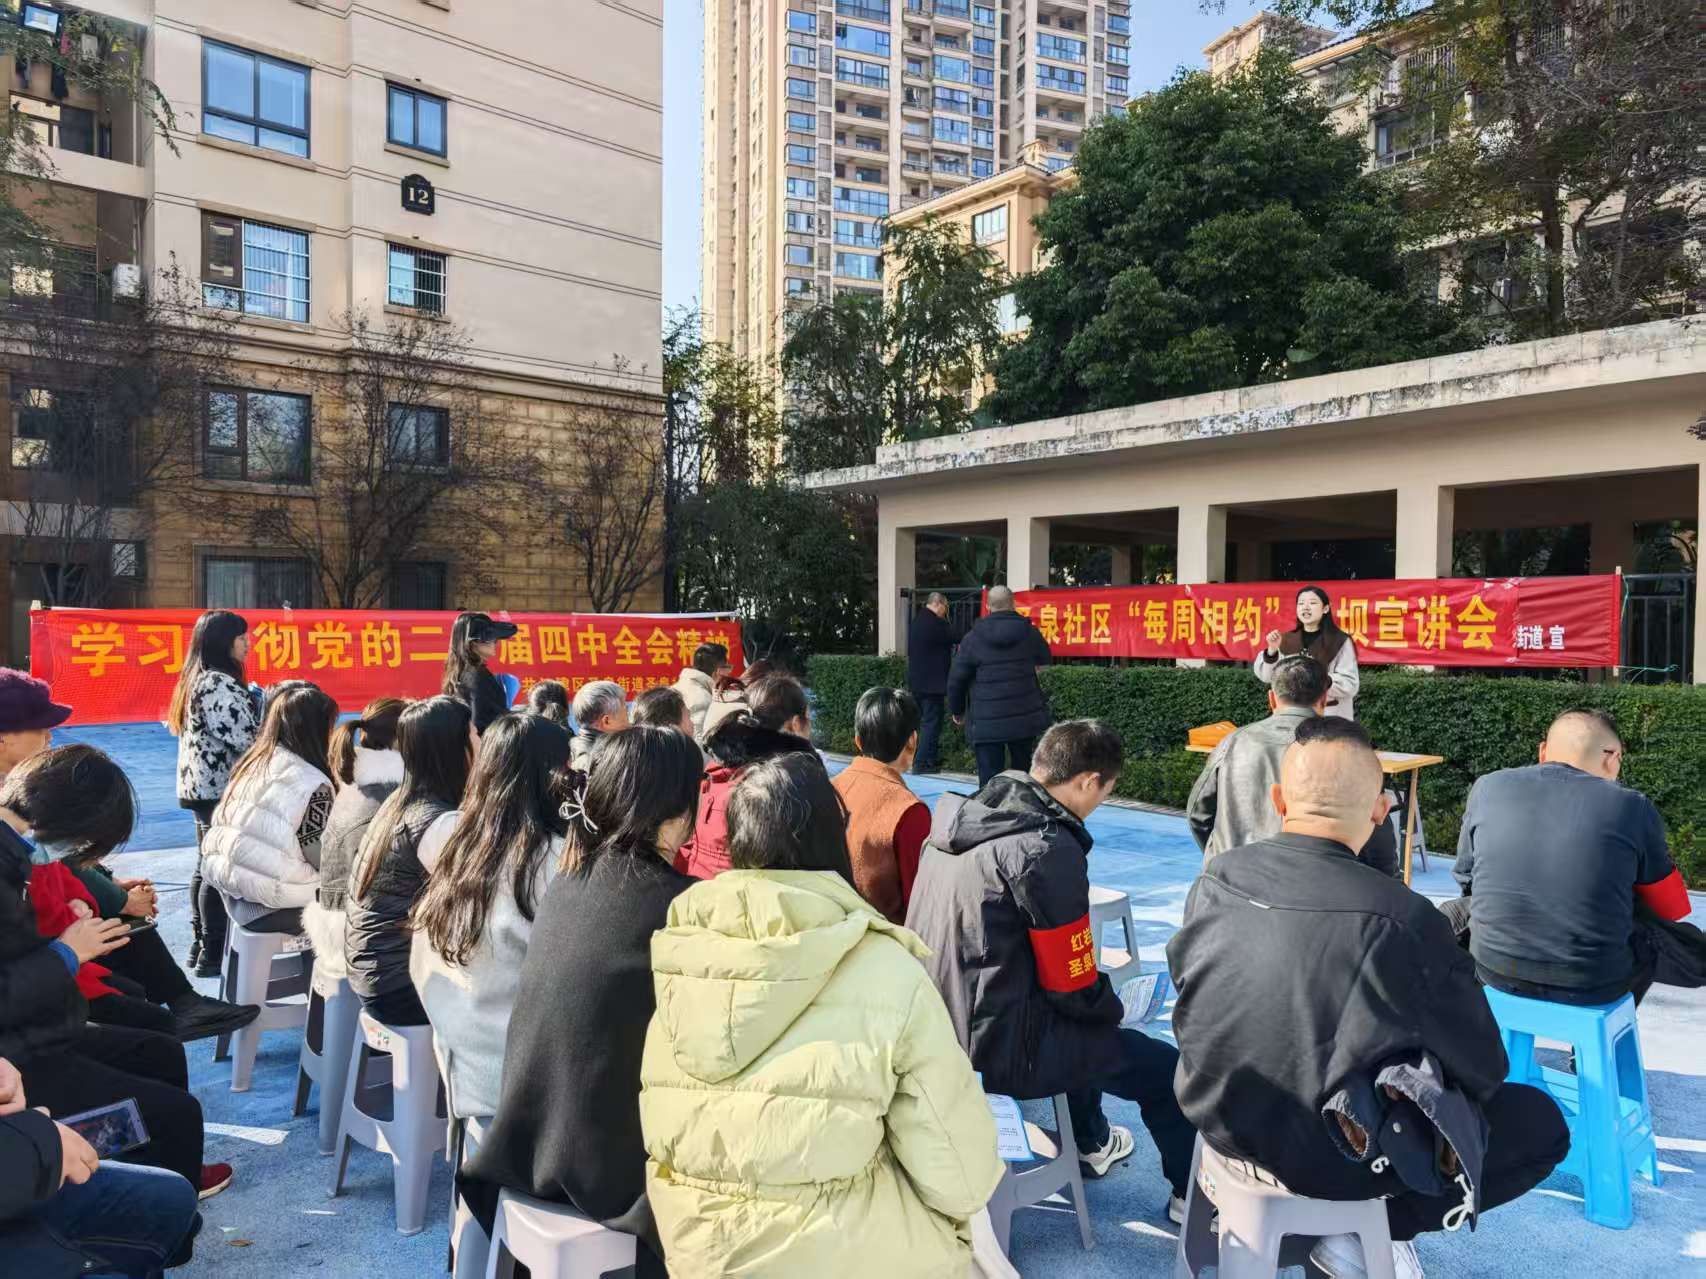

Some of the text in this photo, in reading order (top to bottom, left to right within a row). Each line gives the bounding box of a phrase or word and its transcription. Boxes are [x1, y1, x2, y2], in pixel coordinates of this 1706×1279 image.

[409, 187, 429, 204] 12
[71, 621, 730, 677] 学习彻党的二届四中全会精
[1068, 949, 1096, 979] 圣泉
